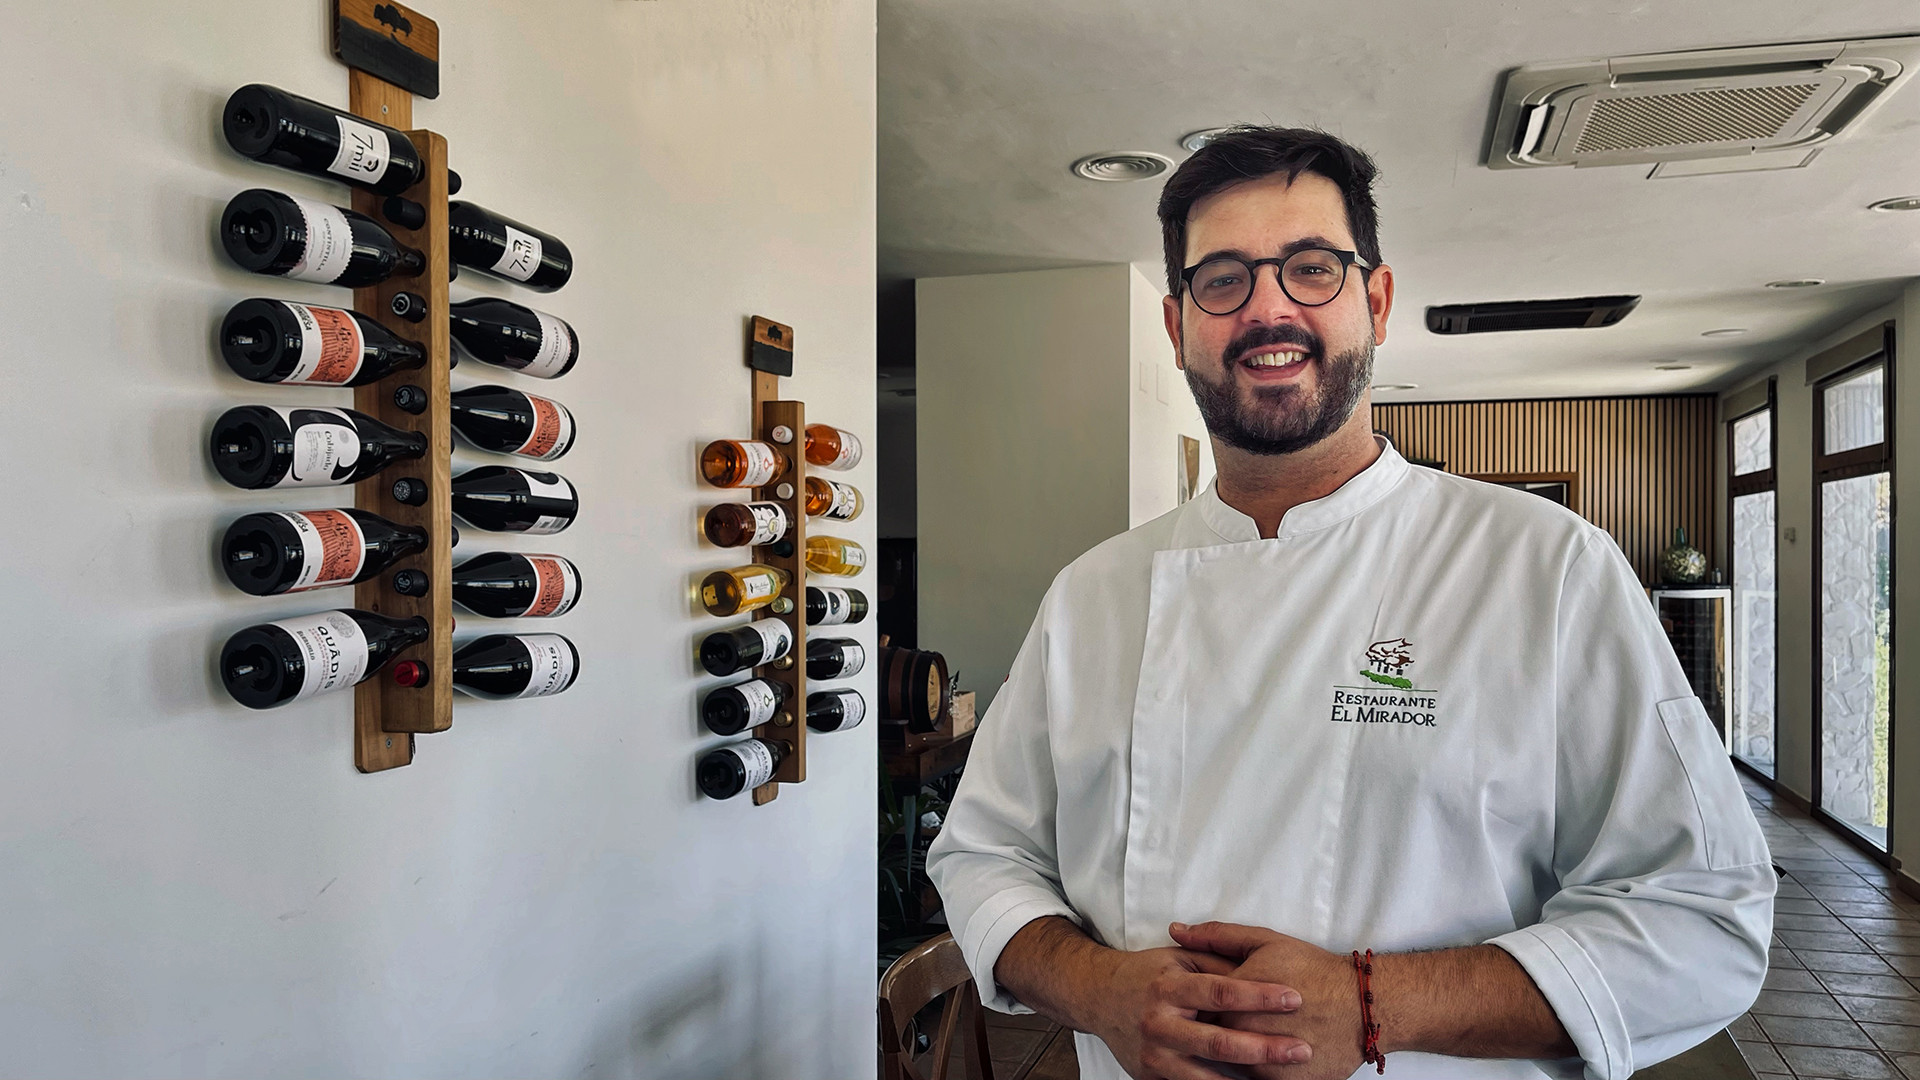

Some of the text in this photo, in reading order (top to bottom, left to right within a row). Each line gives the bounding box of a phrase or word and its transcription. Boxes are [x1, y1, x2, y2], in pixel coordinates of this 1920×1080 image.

[323, 431, 334, 471] Cobijado
[1333, 690, 1436, 709] RESTAURANTE
[1330, 704, 1437, 727] EL MIRADOR
